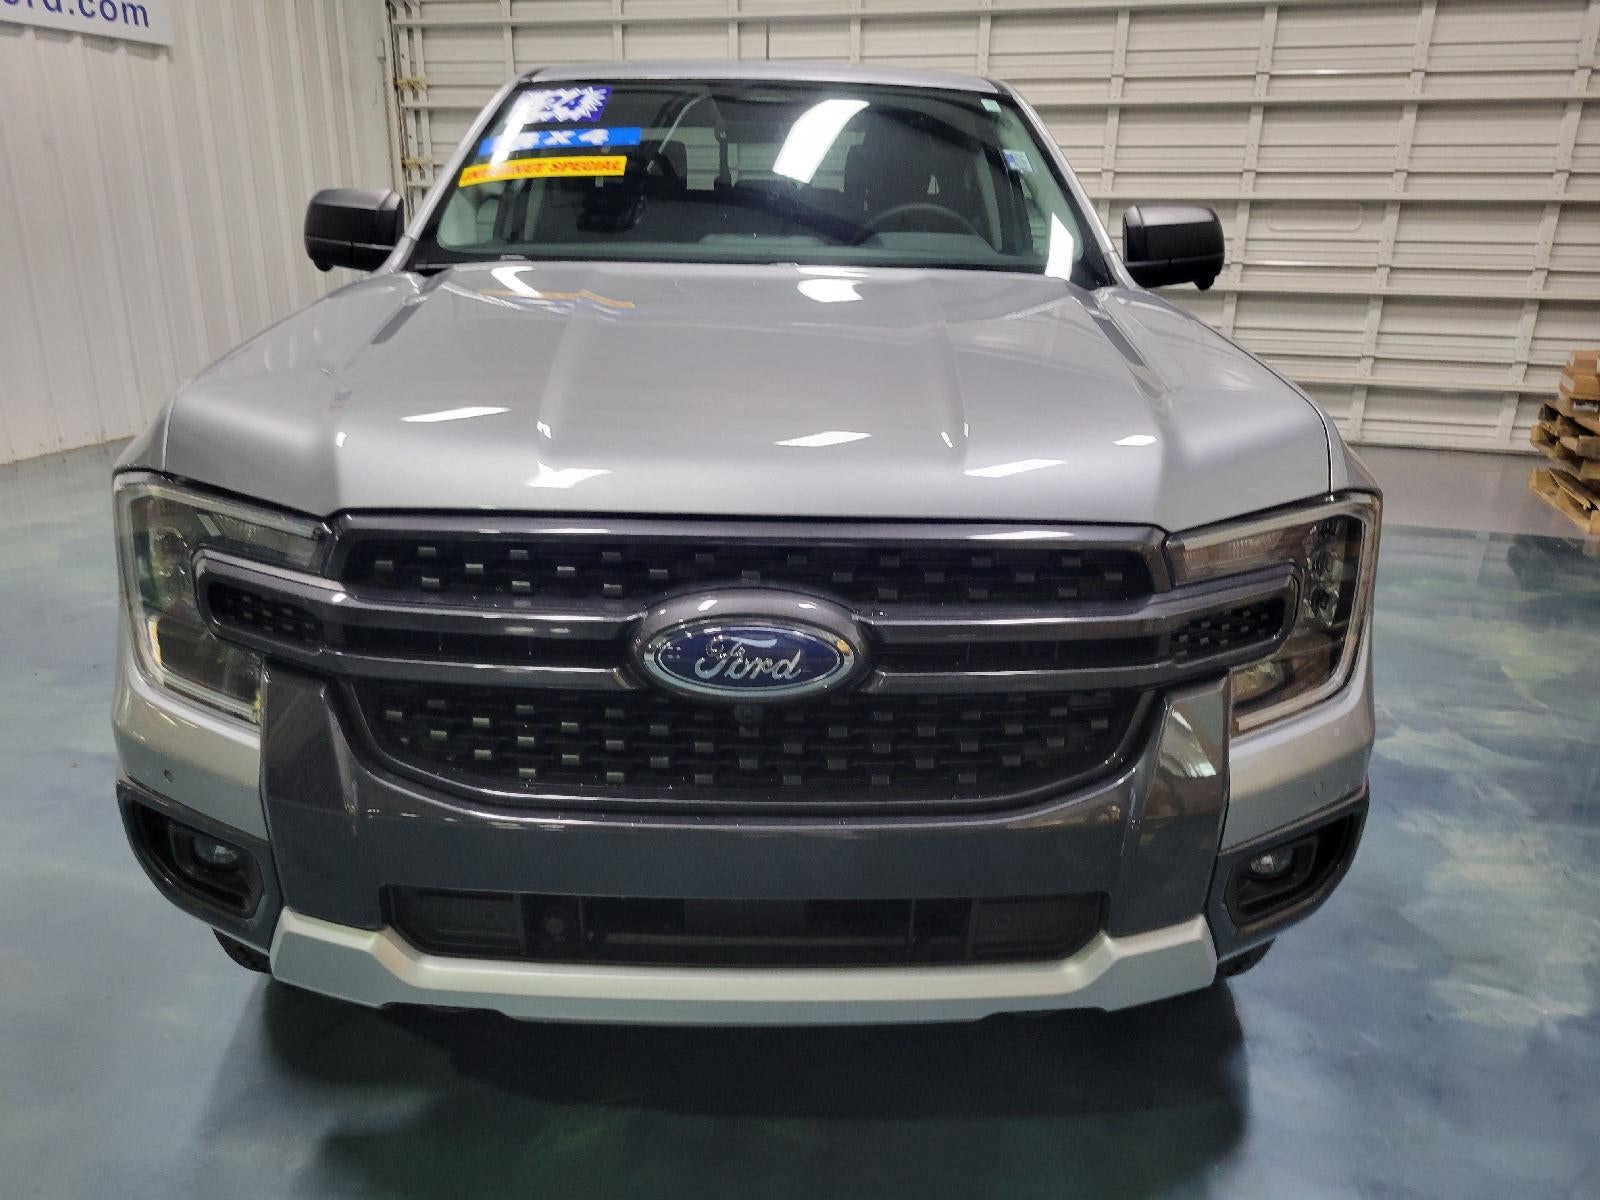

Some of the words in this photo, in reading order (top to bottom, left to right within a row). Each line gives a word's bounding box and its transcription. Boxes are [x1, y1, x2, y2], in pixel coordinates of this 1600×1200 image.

[3, 0, 149, 28] .com
[463, 163, 545, 180] INNET
[550, 161, 620, 173] SPECIAL
[694, 635, 802, 679] Ford
